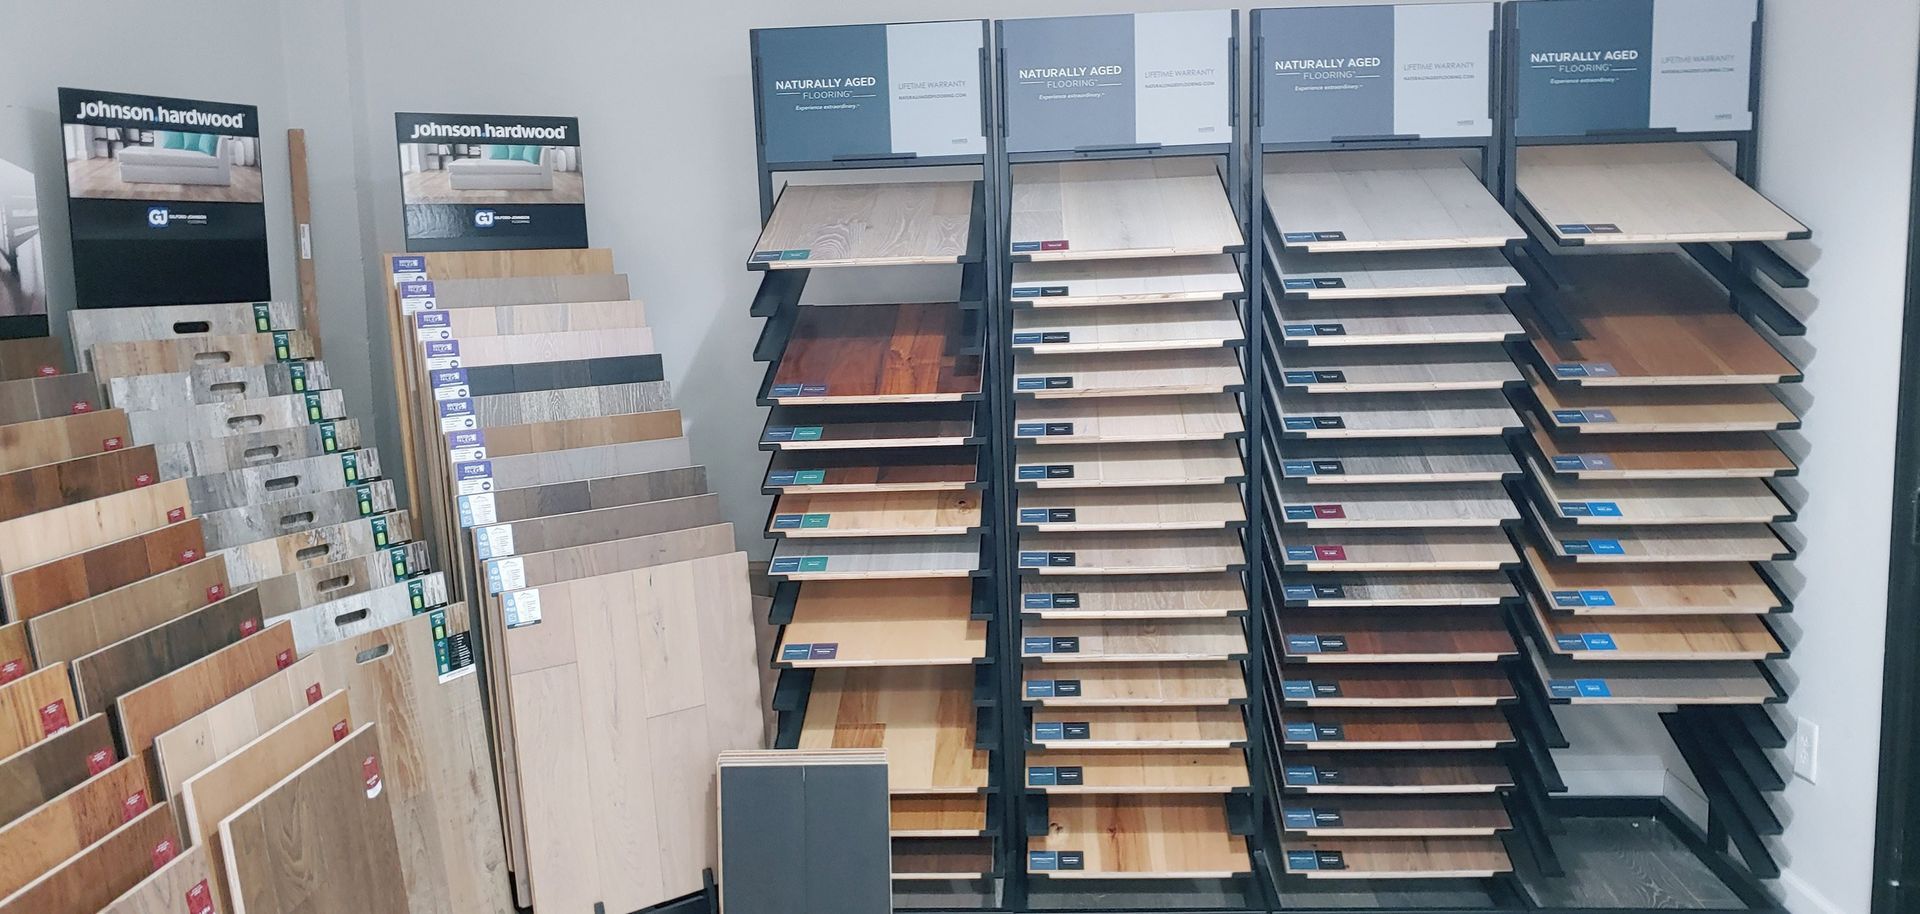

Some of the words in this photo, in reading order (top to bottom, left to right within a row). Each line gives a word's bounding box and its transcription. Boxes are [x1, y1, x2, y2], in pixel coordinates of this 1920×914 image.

[1531, 51, 1601, 63] NATURALLY
[1604, 50, 1638, 60] AGED
[1275, 58, 1345, 70] NATURALLY
[1348, 57, 1381, 67] AGED
[1019, 67, 1087, 79] NATURALLY
[1090, 65, 1122, 76] AGED
[776, 78, 842, 90] NATURALLY
[844, 77, 876, 87] AGED
